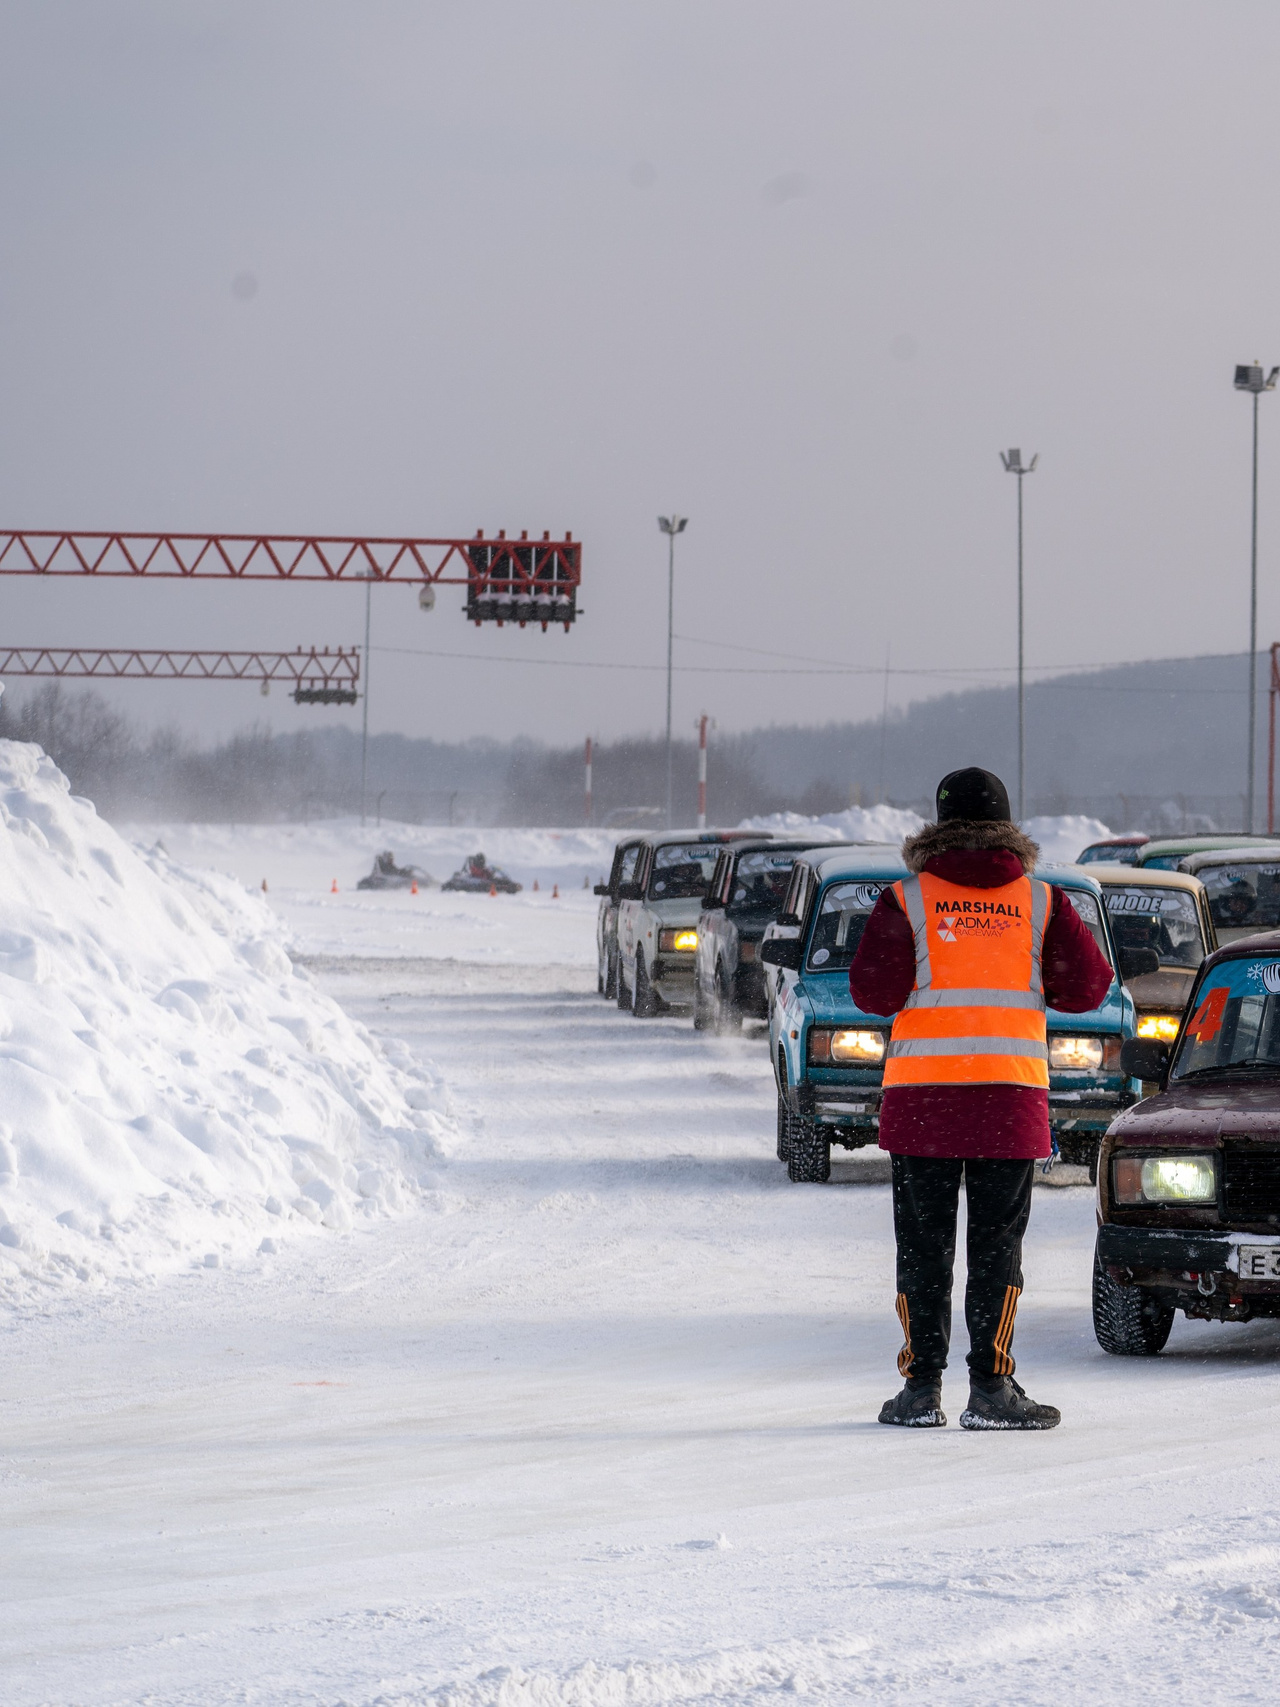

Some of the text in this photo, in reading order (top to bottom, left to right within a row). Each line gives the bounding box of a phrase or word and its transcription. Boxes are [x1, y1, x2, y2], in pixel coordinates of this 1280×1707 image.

[935, 901, 1021, 918] MARSHALL
[1108, 895, 1162, 912] MODE
[955, 917, 990, 929] ADM
[954, 928, 1004, 937] RACEWAY
[1186, 986, 1231, 1042] 4
